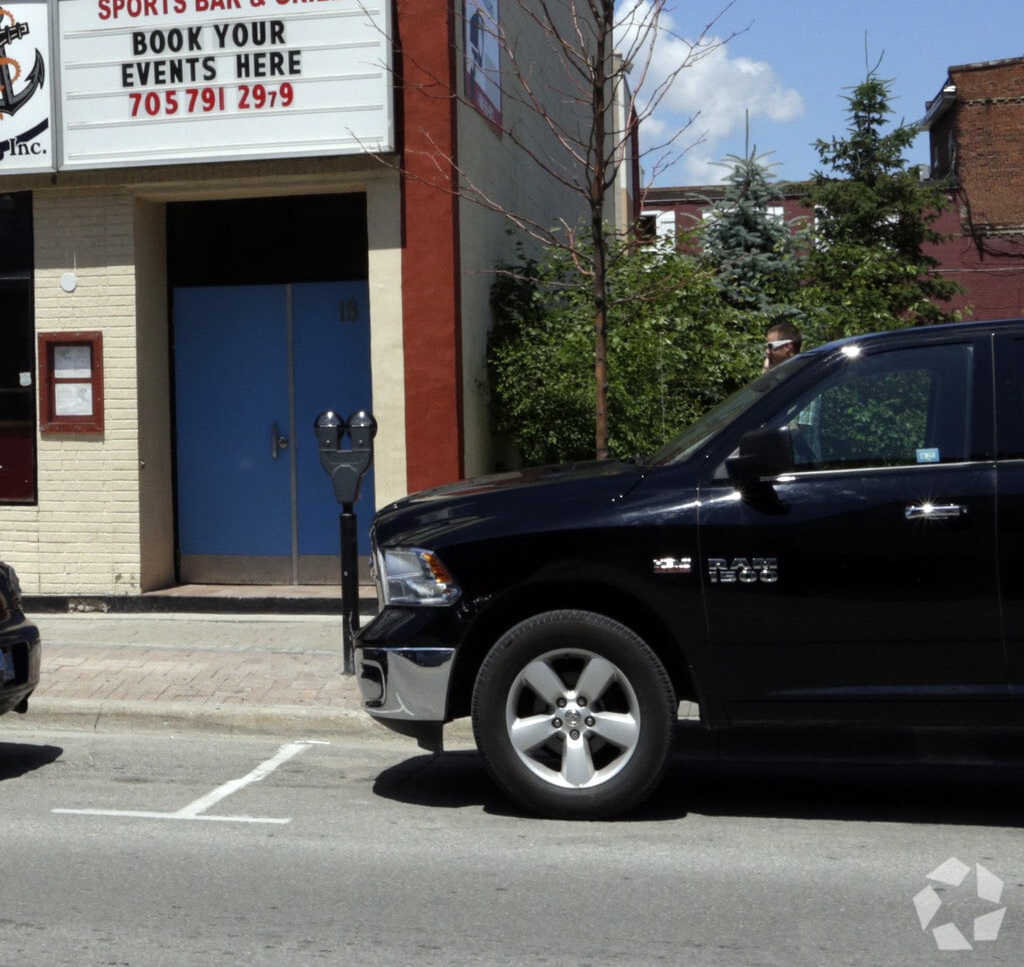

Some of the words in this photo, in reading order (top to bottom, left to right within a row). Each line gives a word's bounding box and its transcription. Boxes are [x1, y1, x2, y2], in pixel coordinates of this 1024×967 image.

[132, 26, 203, 56] BOOK
[213, 20, 286, 49] YOUR
[121, 56, 217, 88] EVENTS
[235, 50, 302, 79] HERE
[129, 90, 179, 117] 705
[185, 86, 225, 113] 791
[238, 82, 294, 110] 2979
[9, 138, 47, 156] Inc.
[708, 558, 778, 570] RAM
[709, 571, 778, 583] 1500
